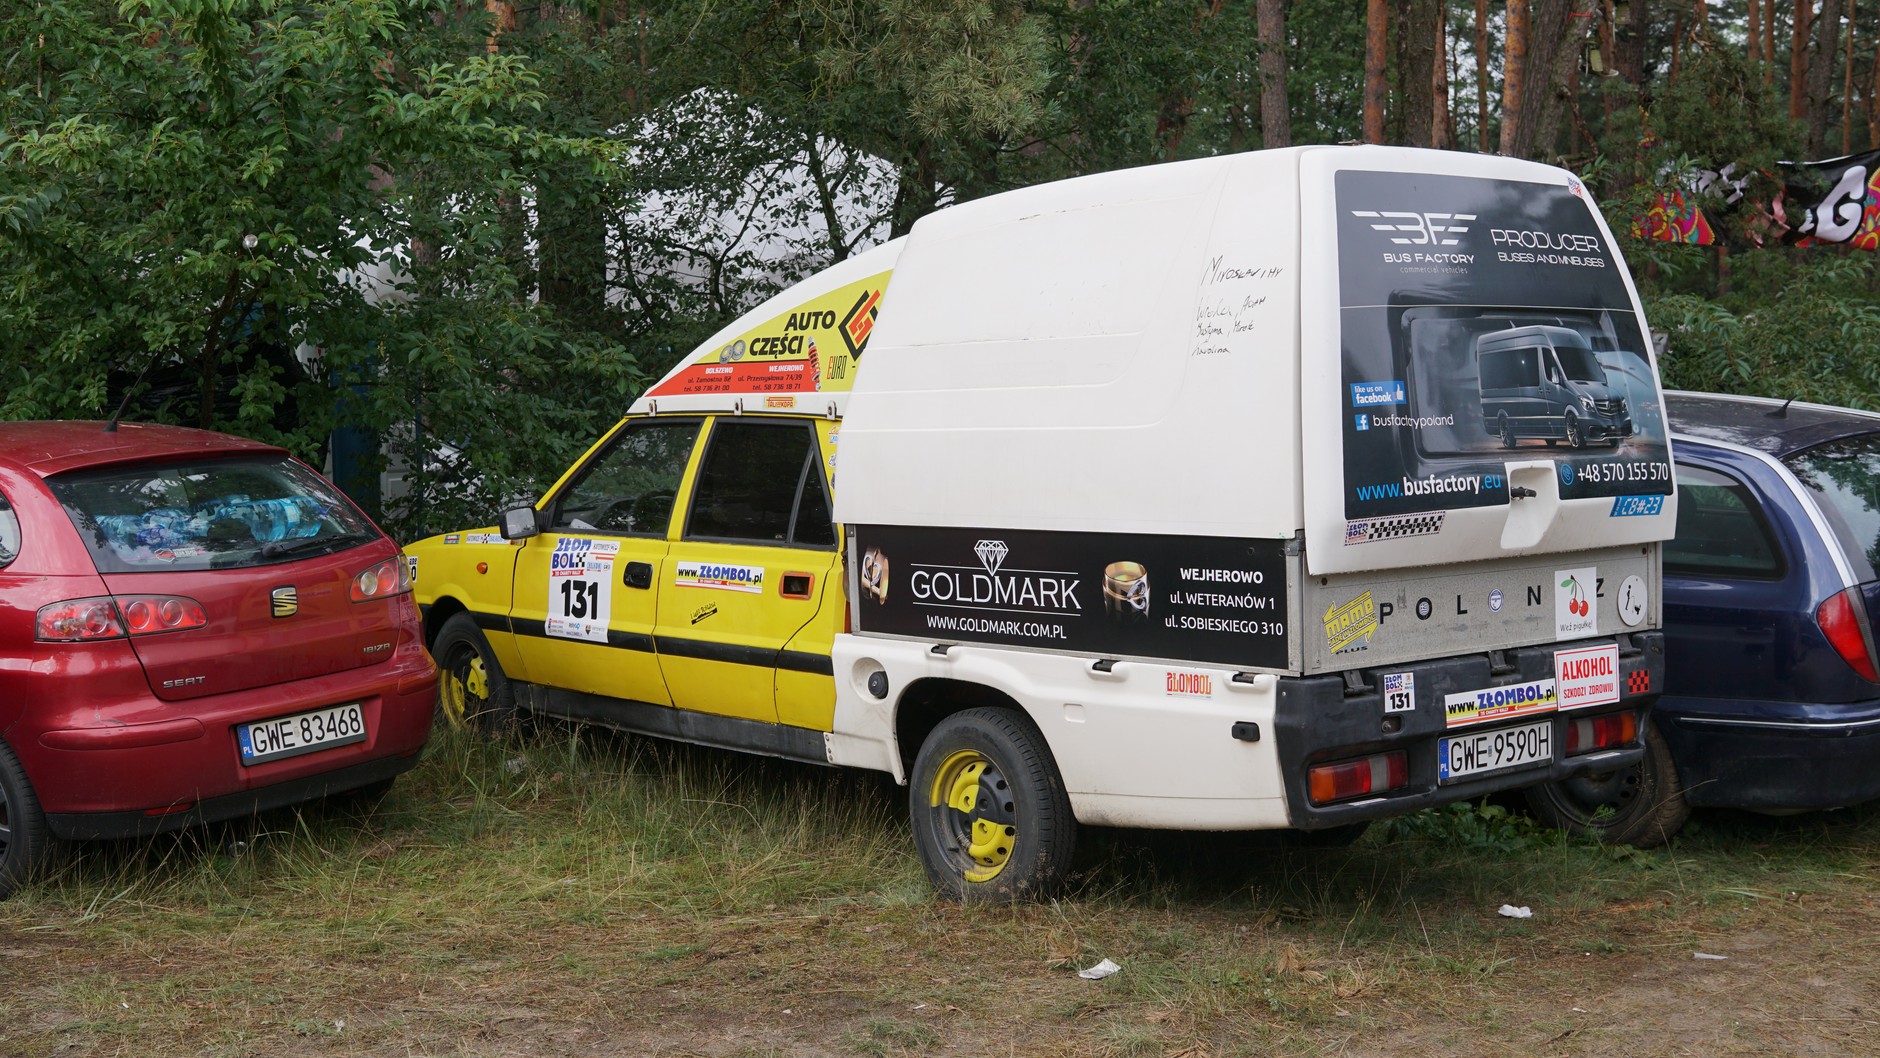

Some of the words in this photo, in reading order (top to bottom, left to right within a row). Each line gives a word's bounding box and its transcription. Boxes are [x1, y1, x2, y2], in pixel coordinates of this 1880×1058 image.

[1490, 228, 1601, 253] PRODUCER
[1383, 253, 1412, 263] BUS
[1414, 253, 1475, 264] FACTORY
[1497, 251, 1535, 263] BUSES
[1536, 254, 1558, 264] AND
[1400, 265, 1439, 274] commercial
[1441, 266, 1468, 274] vehicles
[784, 310, 836, 332] AUTO
[749, 332, 804, 360] CZĘŚCI
[768, 364, 805, 373] WEJHEROWO
[826, 355, 848, 380] EURO
[1356, 391, 1392, 404] facebook
[1372, 413, 1454, 430] busfactorypoland
[1577, 463, 1601, 483] +48
[1602, 462, 1625, 482] 570
[1626, 462, 1648, 480] 155
[1650, 462, 1669, 480] 570
[1356, 473, 1502, 501] www.busfactory.eu
[555, 537, 593, 552] ZŁOM
[678, 565, 763, 585] www.ZŁOMBOL.pl
[1180, 567, 1264, 584] WEJHEROWO
[561, 579, 598, 620] 131
[910, 570, 1082, 610] GOLDMARK
[1169, 590, 1184, 604] ul.
[1185, 592, 1266, 610] WETERANÓW
[1268, 597, 1275, 610] 1
[926, 614, 1067, 639] WWW.GOLDMARK.COM.PL
[1165, 614, 1179, 628] ul.
[1180, 616, 1259, 634] SOBIESKIEGO
[1261, 622, 1283, 636] 310
[363, 643, 391, 653] IBIZA
[1562, 656, 1613, 681] ALKOHOL
[163, 675, 206, 688] SEAT
[1563, 686, 1587, 699] SZKODZI
[1588, 683, 1614, 694] ZDROWIU
[1390, 692, 1410, 710] 131
[1448, 684, 1555, 714] www.ZŁOMBOL.pl
[243, 746, 252, 754] PL
[253, 720, 296, 754] GWE
[300, 707, 361, 744] 83468
[1440, 763, 1448, 772] PL
[1451, 736, 1488, 773] GWE
[1494, 725, 1549, 766] 9590H
